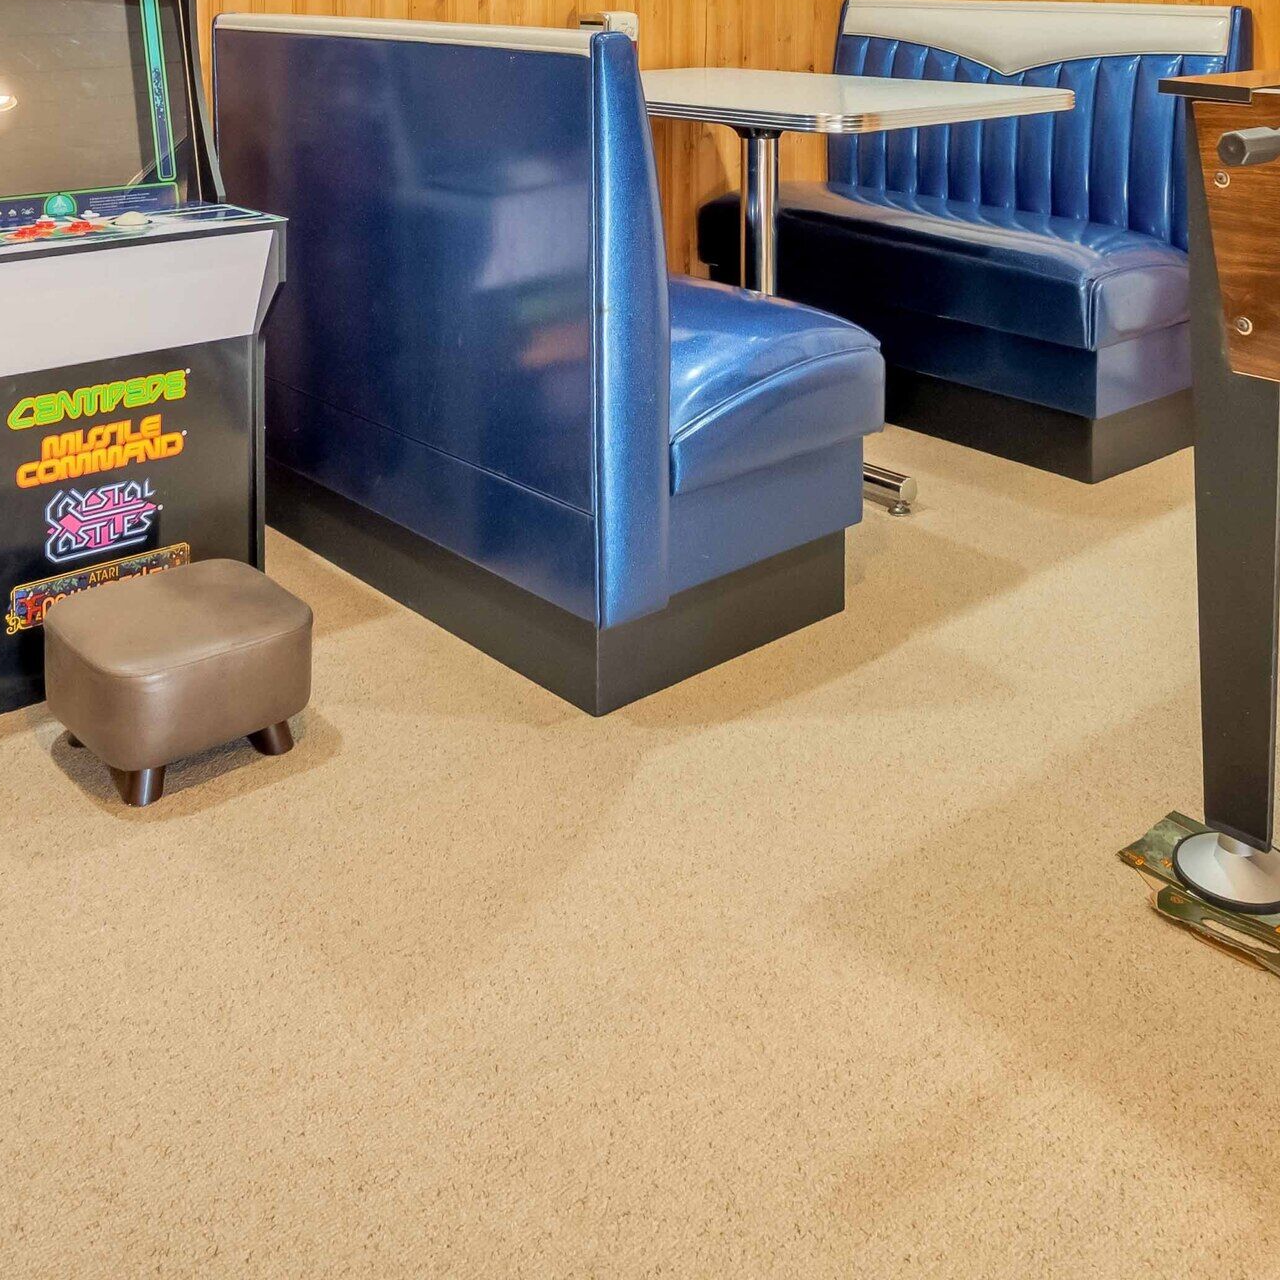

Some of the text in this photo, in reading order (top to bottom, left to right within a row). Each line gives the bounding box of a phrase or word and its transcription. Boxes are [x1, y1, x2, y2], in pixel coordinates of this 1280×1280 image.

[7, 369, 187, 431] CENTIPEDE
[16, 432, 184, 488] COMMAND
[41, 413, 162, 461] MISSILE
[89, 566, 119, 583] ATARI
